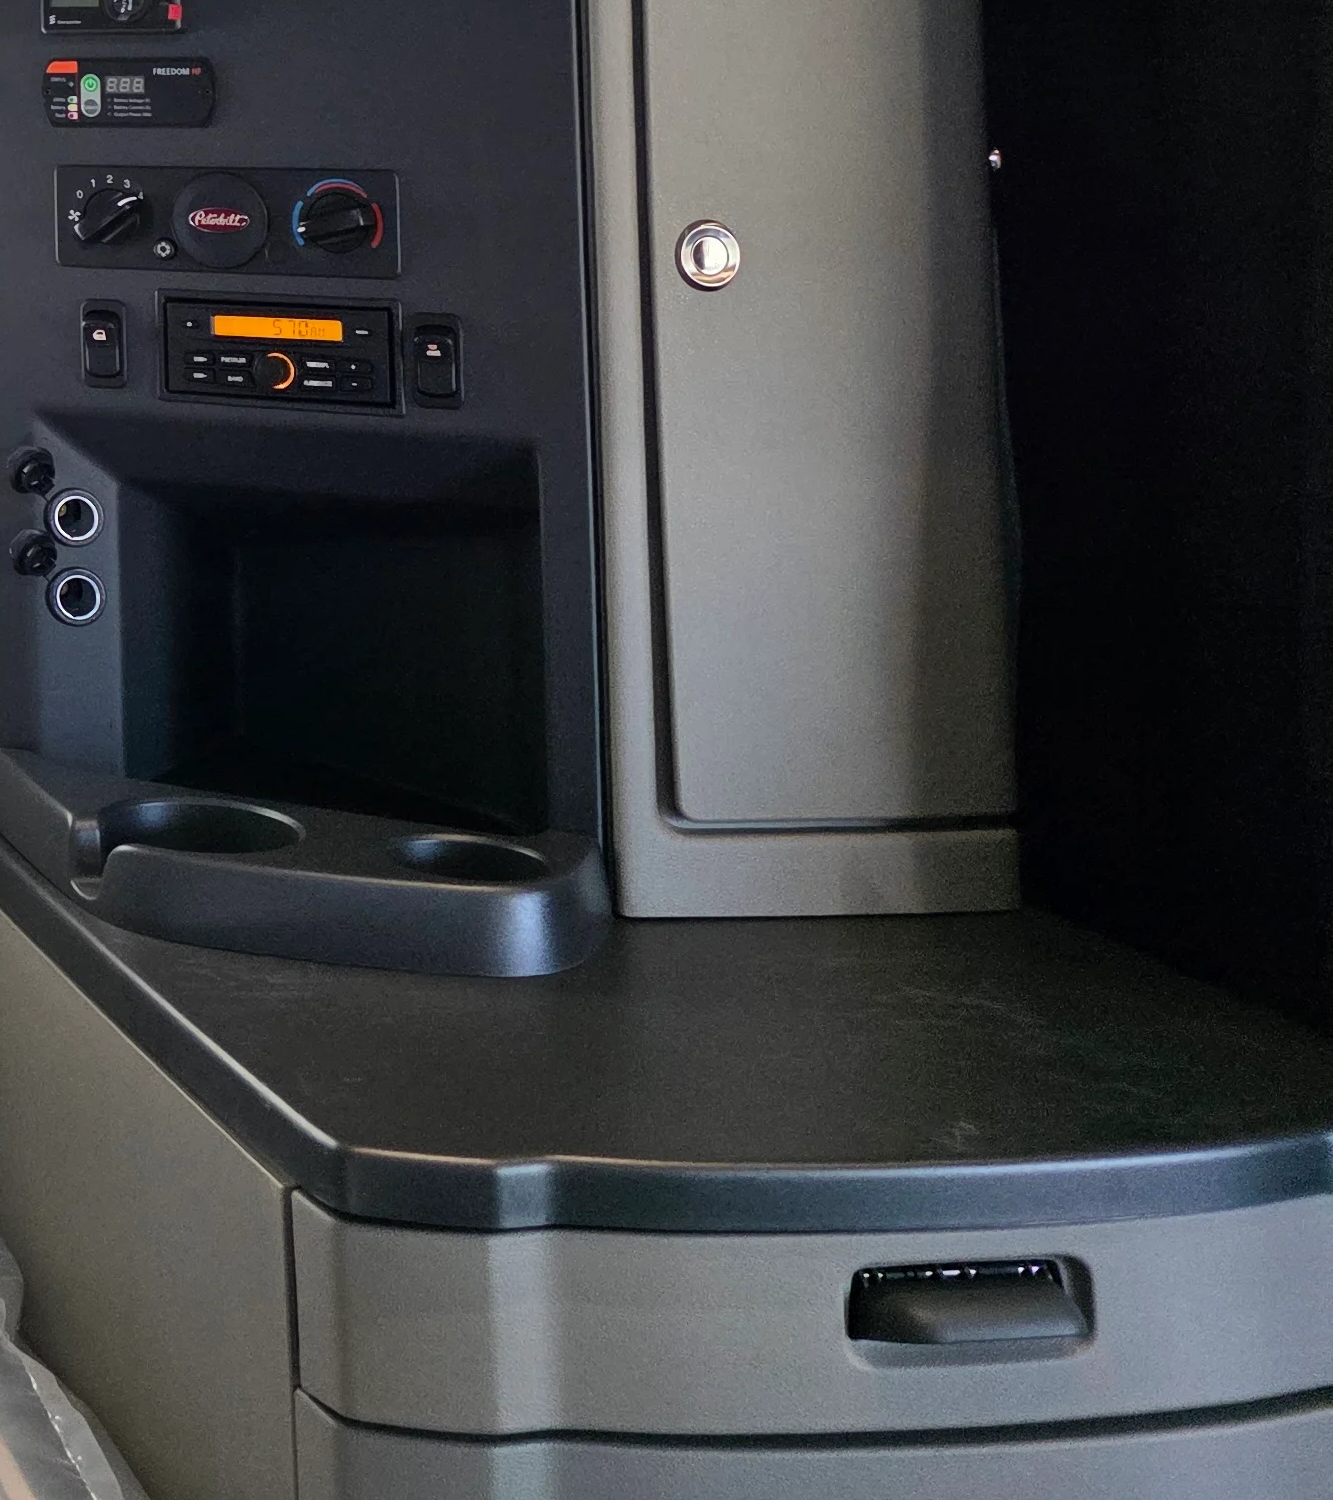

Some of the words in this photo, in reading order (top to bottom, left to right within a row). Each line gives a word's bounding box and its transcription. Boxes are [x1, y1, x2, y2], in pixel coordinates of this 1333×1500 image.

[153, 67, 190, 76] FREEDOM
[76, 189, 84, 199] 0
[90, 178, 96, 188] 1
[106, 174, 114, 184] 2
[123, 178, 131, 189] 3
[194, 209, 247, 227] Peterbilt
